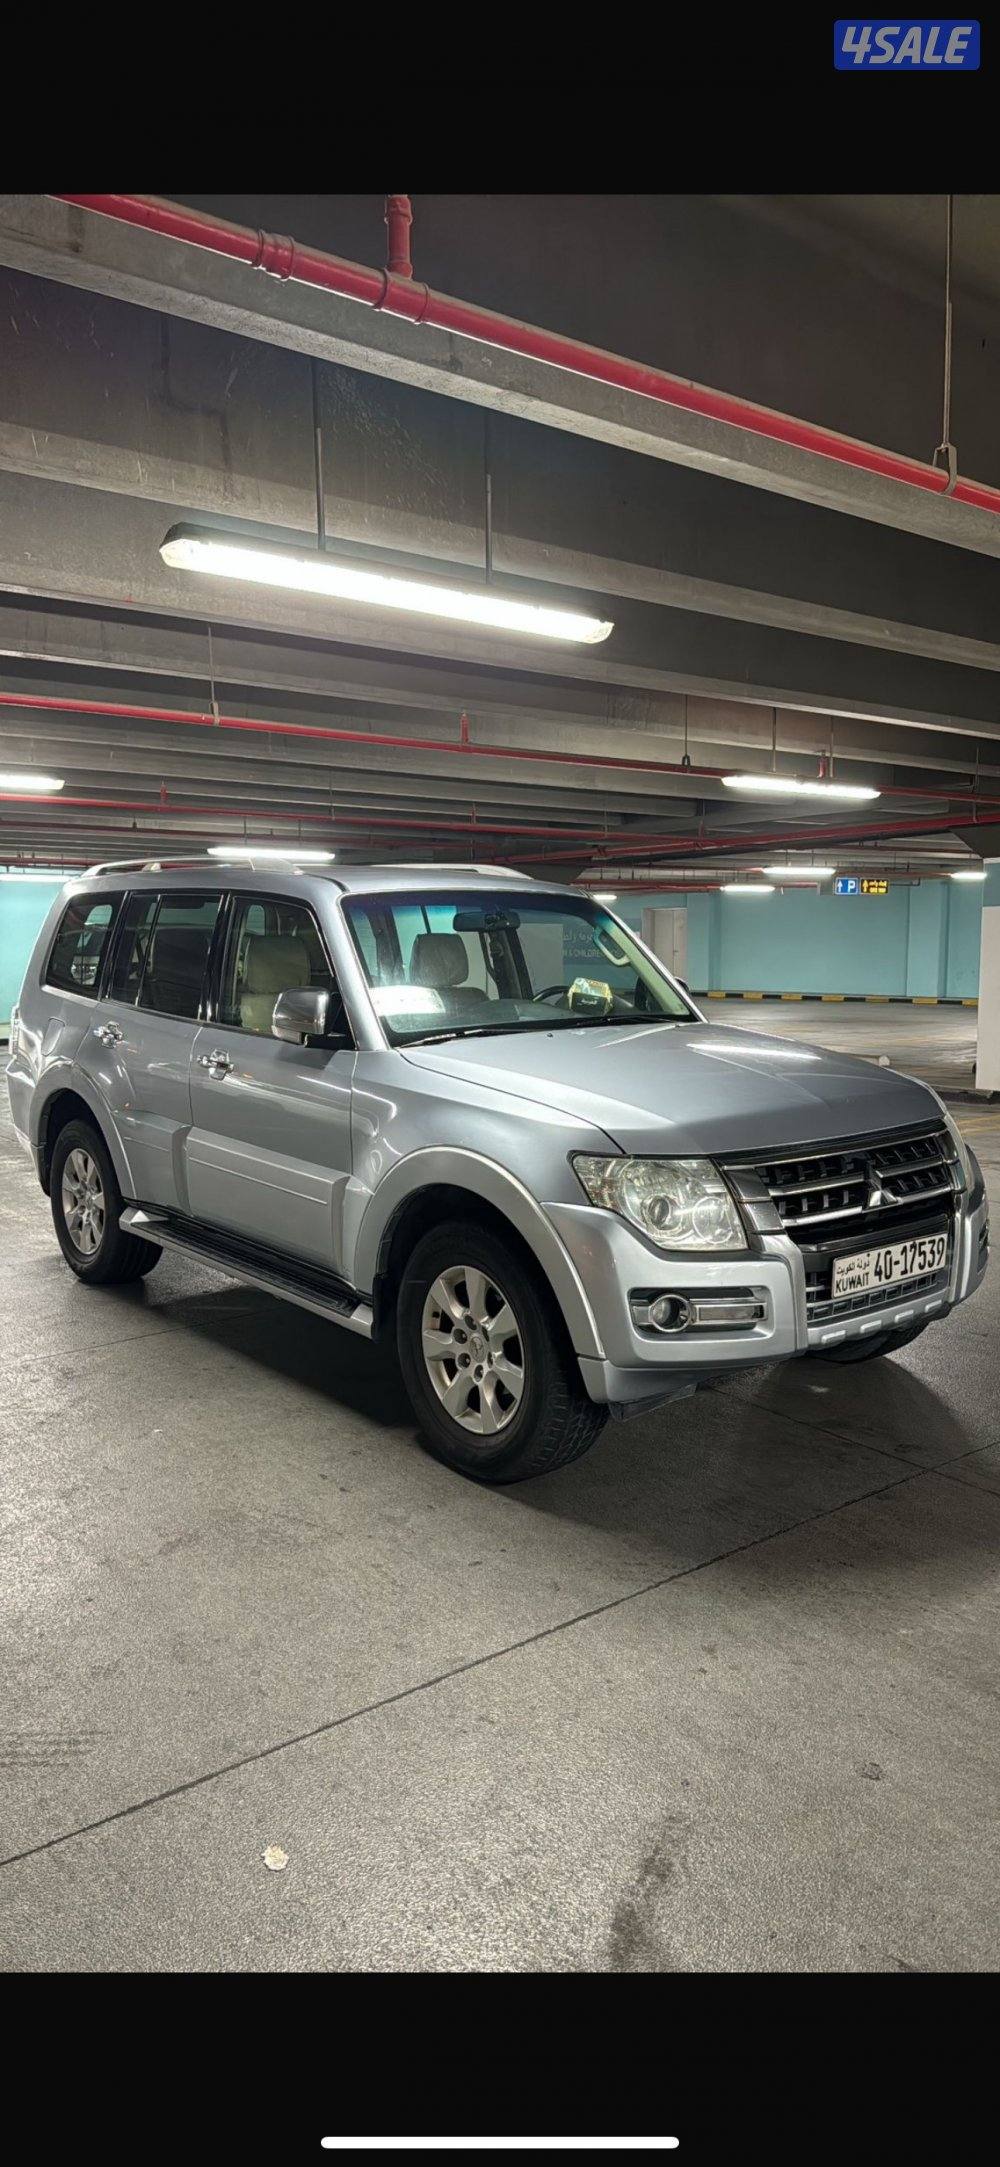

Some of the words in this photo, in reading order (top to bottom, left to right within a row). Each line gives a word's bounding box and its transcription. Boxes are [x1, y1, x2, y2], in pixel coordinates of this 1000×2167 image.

[847, 880, 856, 893] P
[874, 1236, 945, 1283] 40-17539
[835, 1272, 870, 1293] KUWAIT
